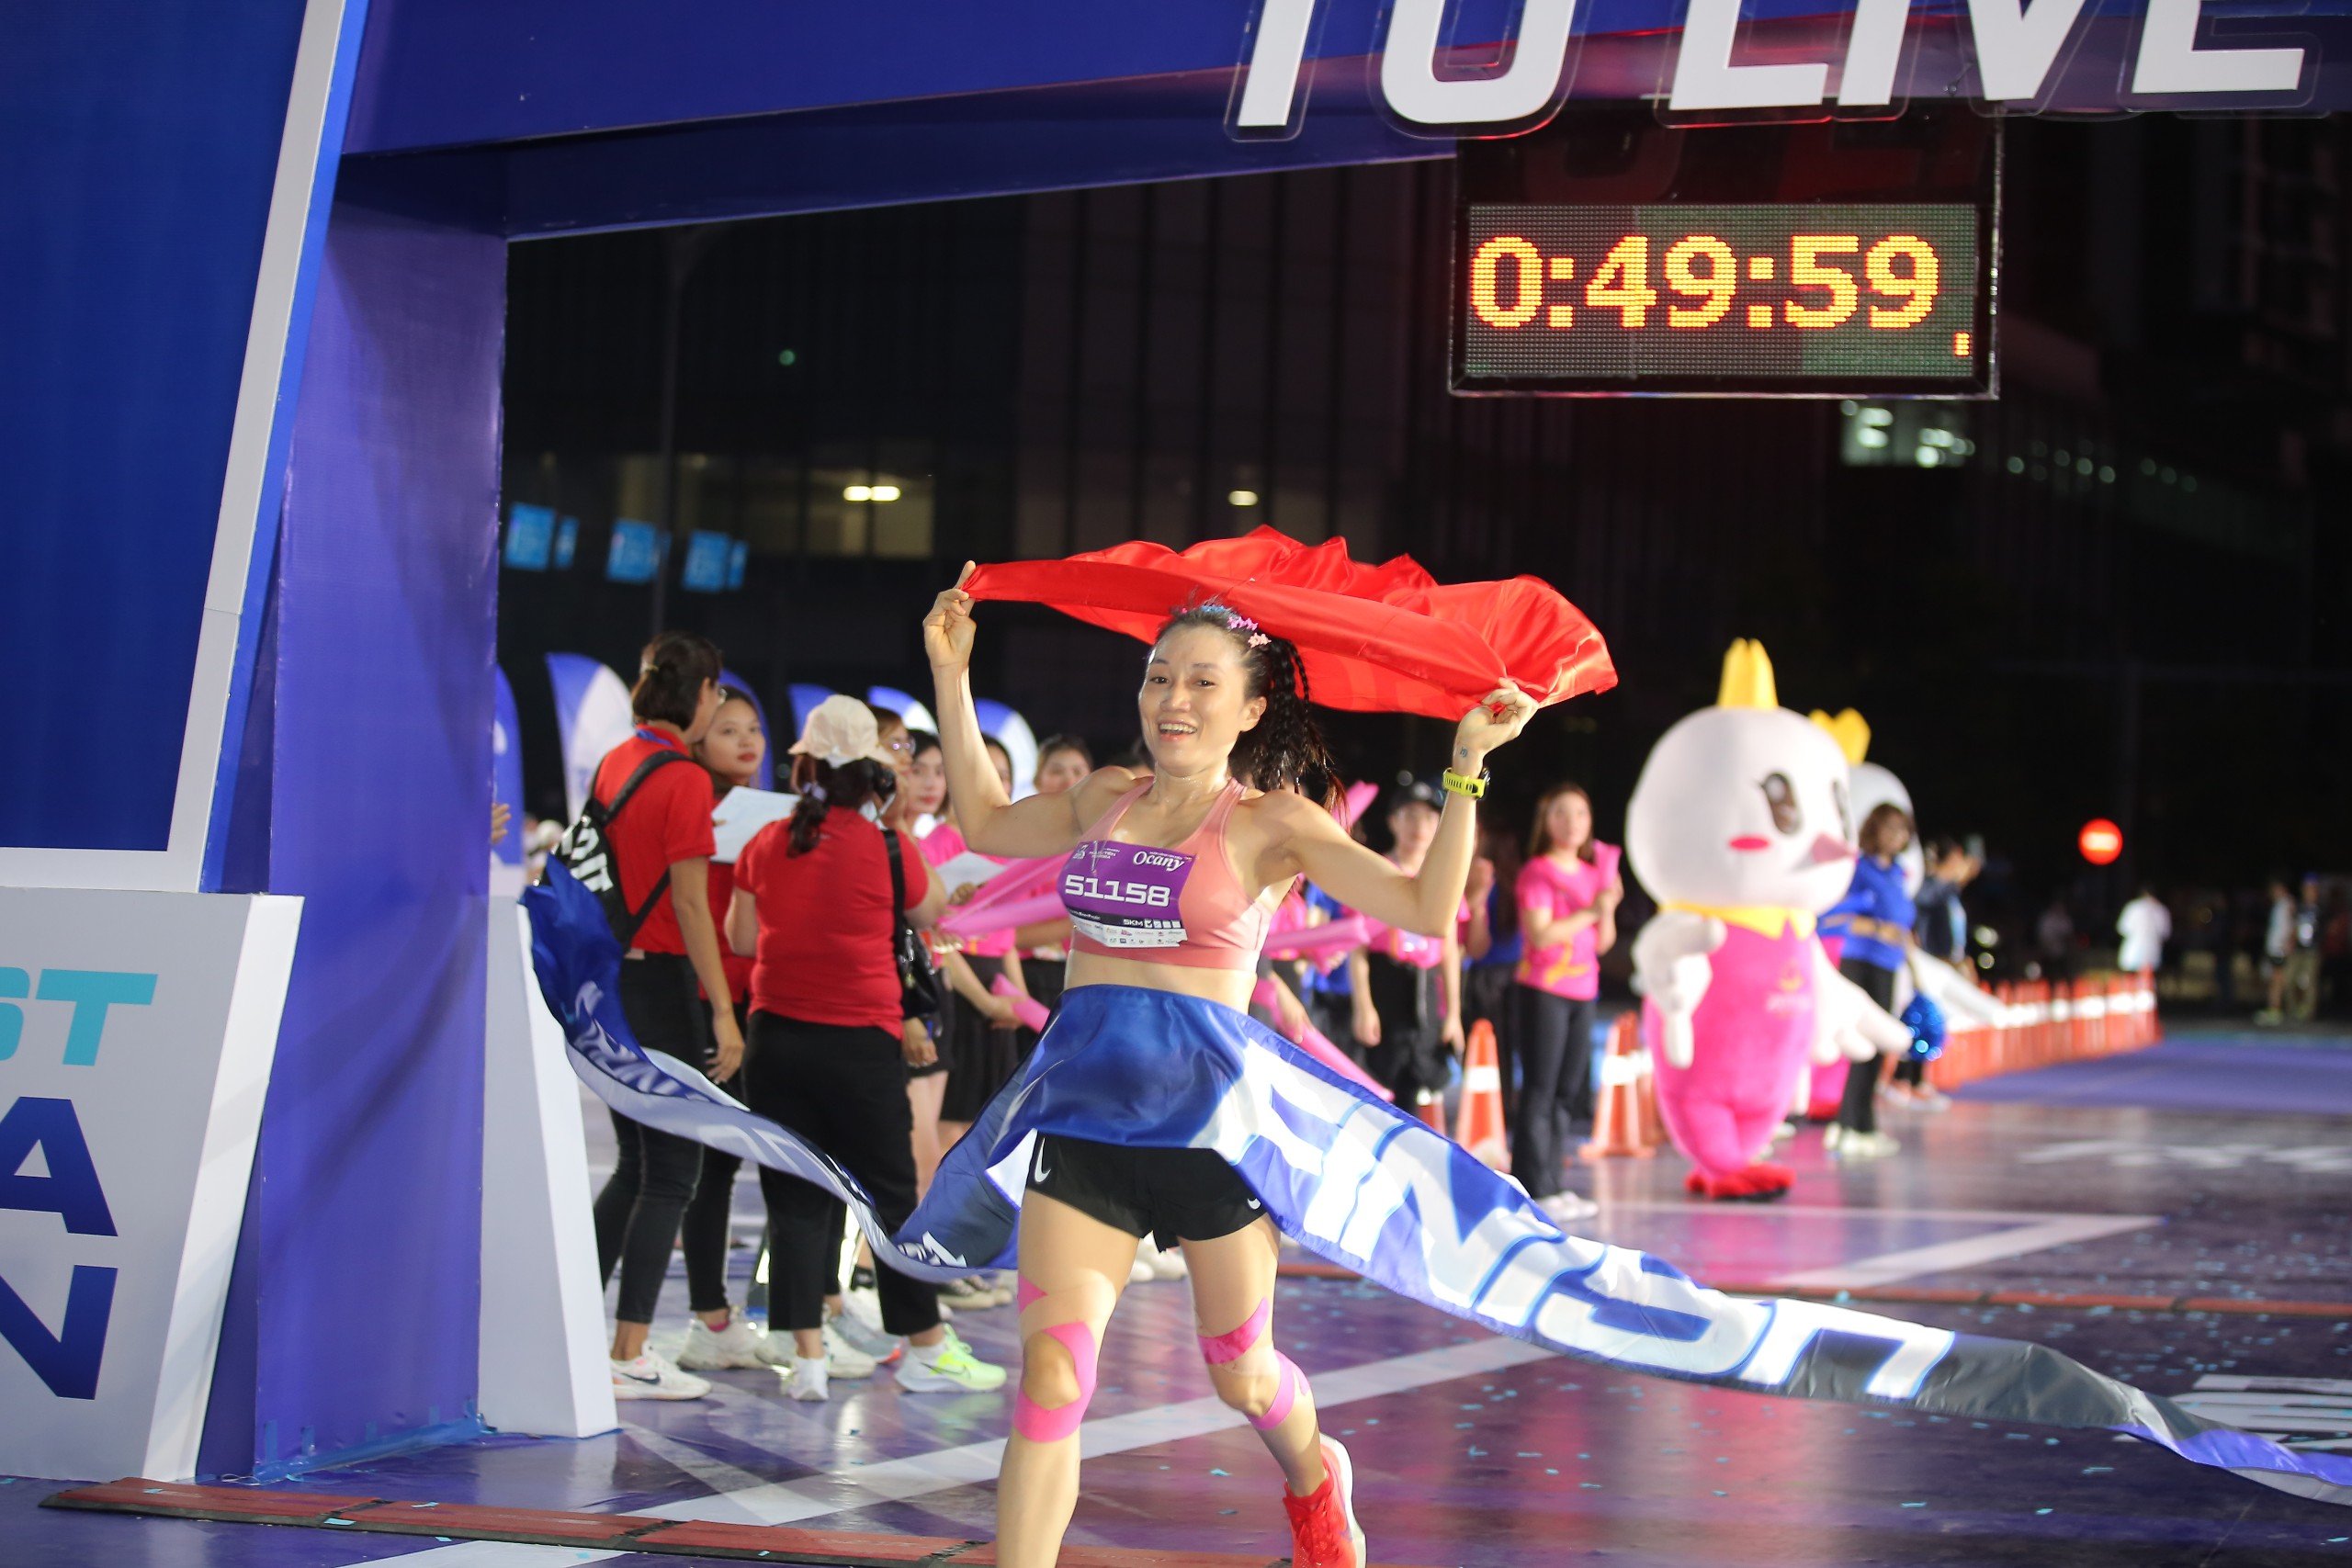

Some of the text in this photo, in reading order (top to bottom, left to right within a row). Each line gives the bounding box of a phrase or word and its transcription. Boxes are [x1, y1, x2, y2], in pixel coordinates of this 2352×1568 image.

[1470, 234, 1940, 329] 0:49:59
[1133, 851, 1185, 872] Ocany
[1065, 874, 1170, 908] 51158
[1122, 919, 1144, 928] 5KM
